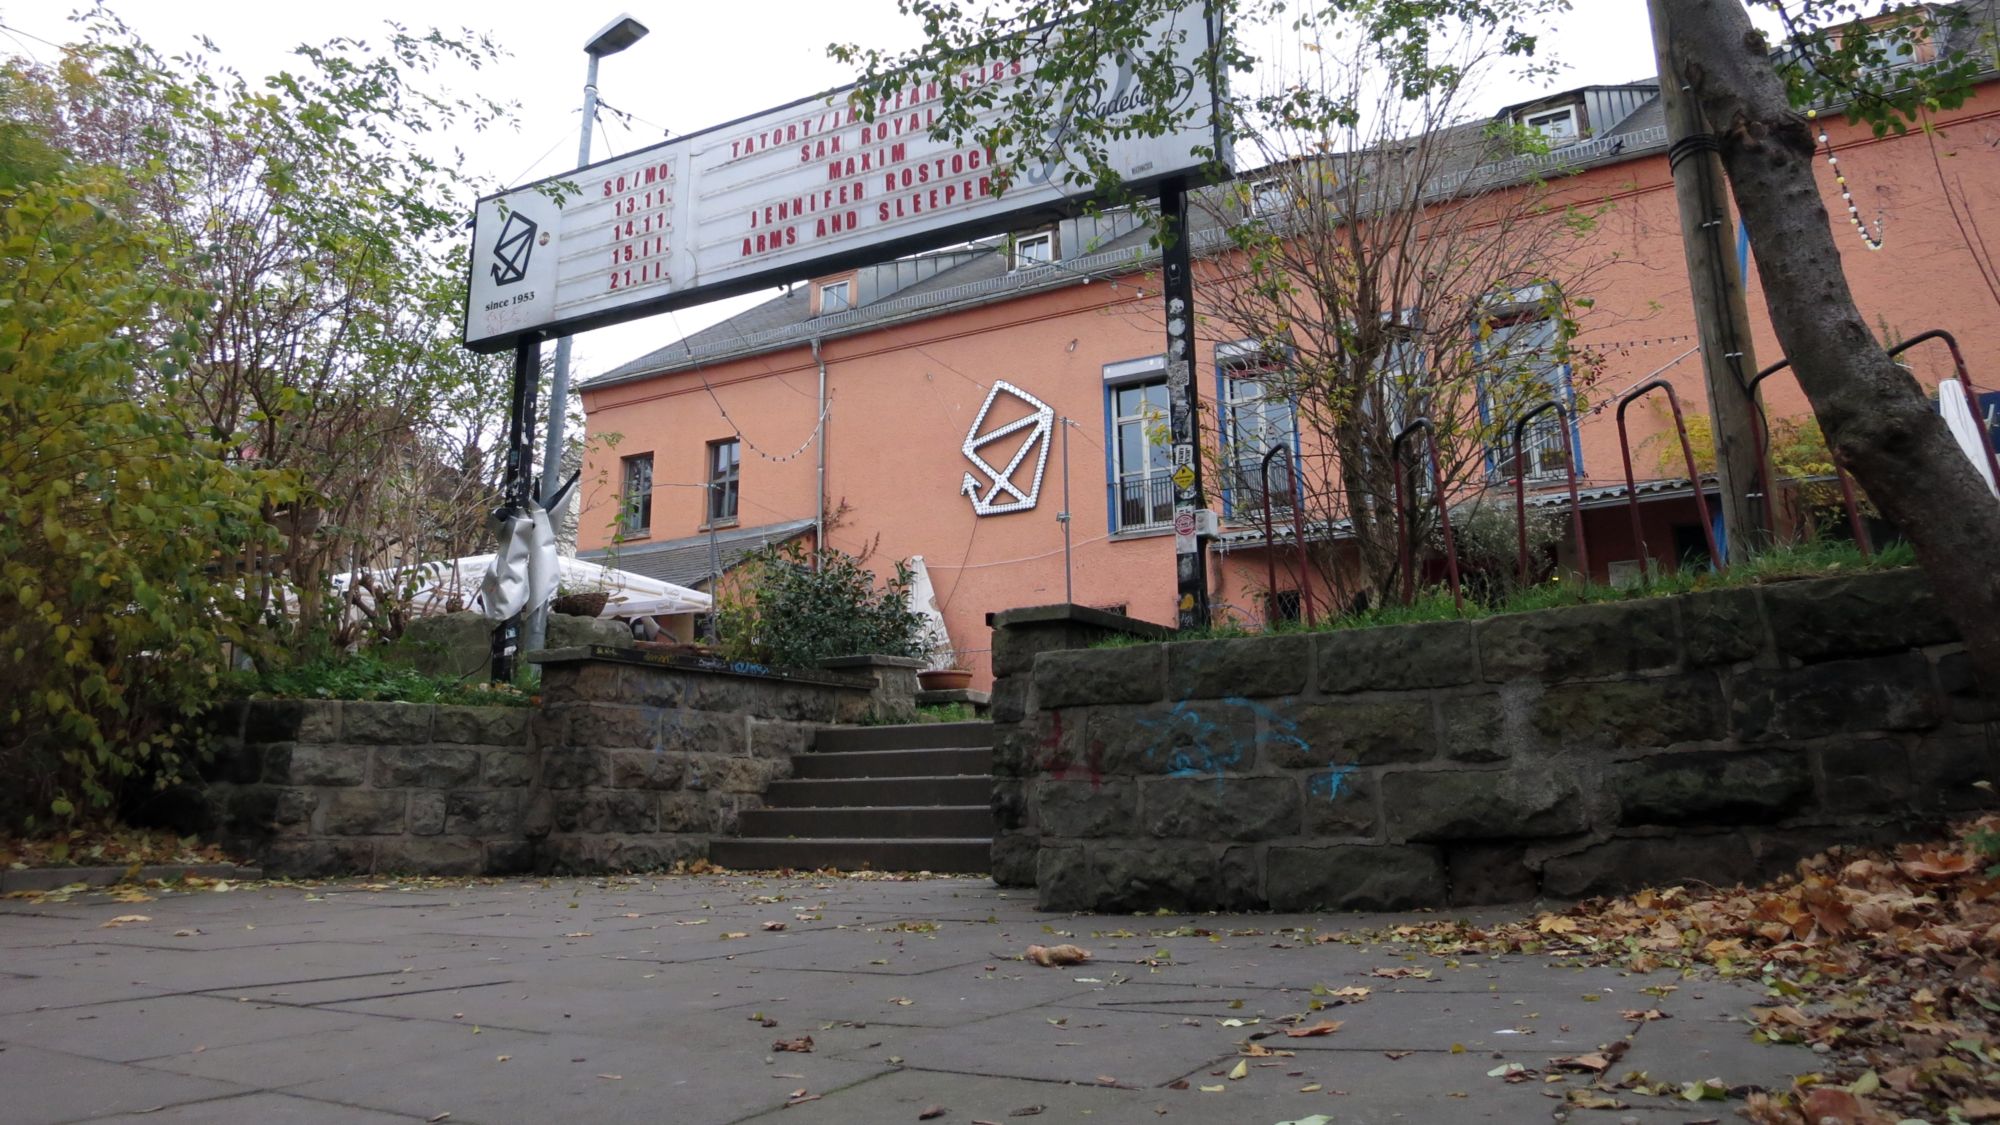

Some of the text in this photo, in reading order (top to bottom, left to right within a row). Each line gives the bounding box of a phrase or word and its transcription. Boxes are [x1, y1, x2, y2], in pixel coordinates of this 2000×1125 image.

[801, 109, 934, 162] SAX ROYAL
[829, 143, 905, 180] MAXIM
[604, 163, 674, 197] SO./MO.
[615, 189, 671, 216] 13.11.
[742, 171, 1009, 256] ARMS AND SLEEPER
[750, 182, 864, 228] JENNIFER
[614, 213, 671, 240] 14.11.
[613, 238, 669, 264] 15.11.
[610, 262, 669, 289] 21.11.
[485, 292, 534, 311] since 1953
